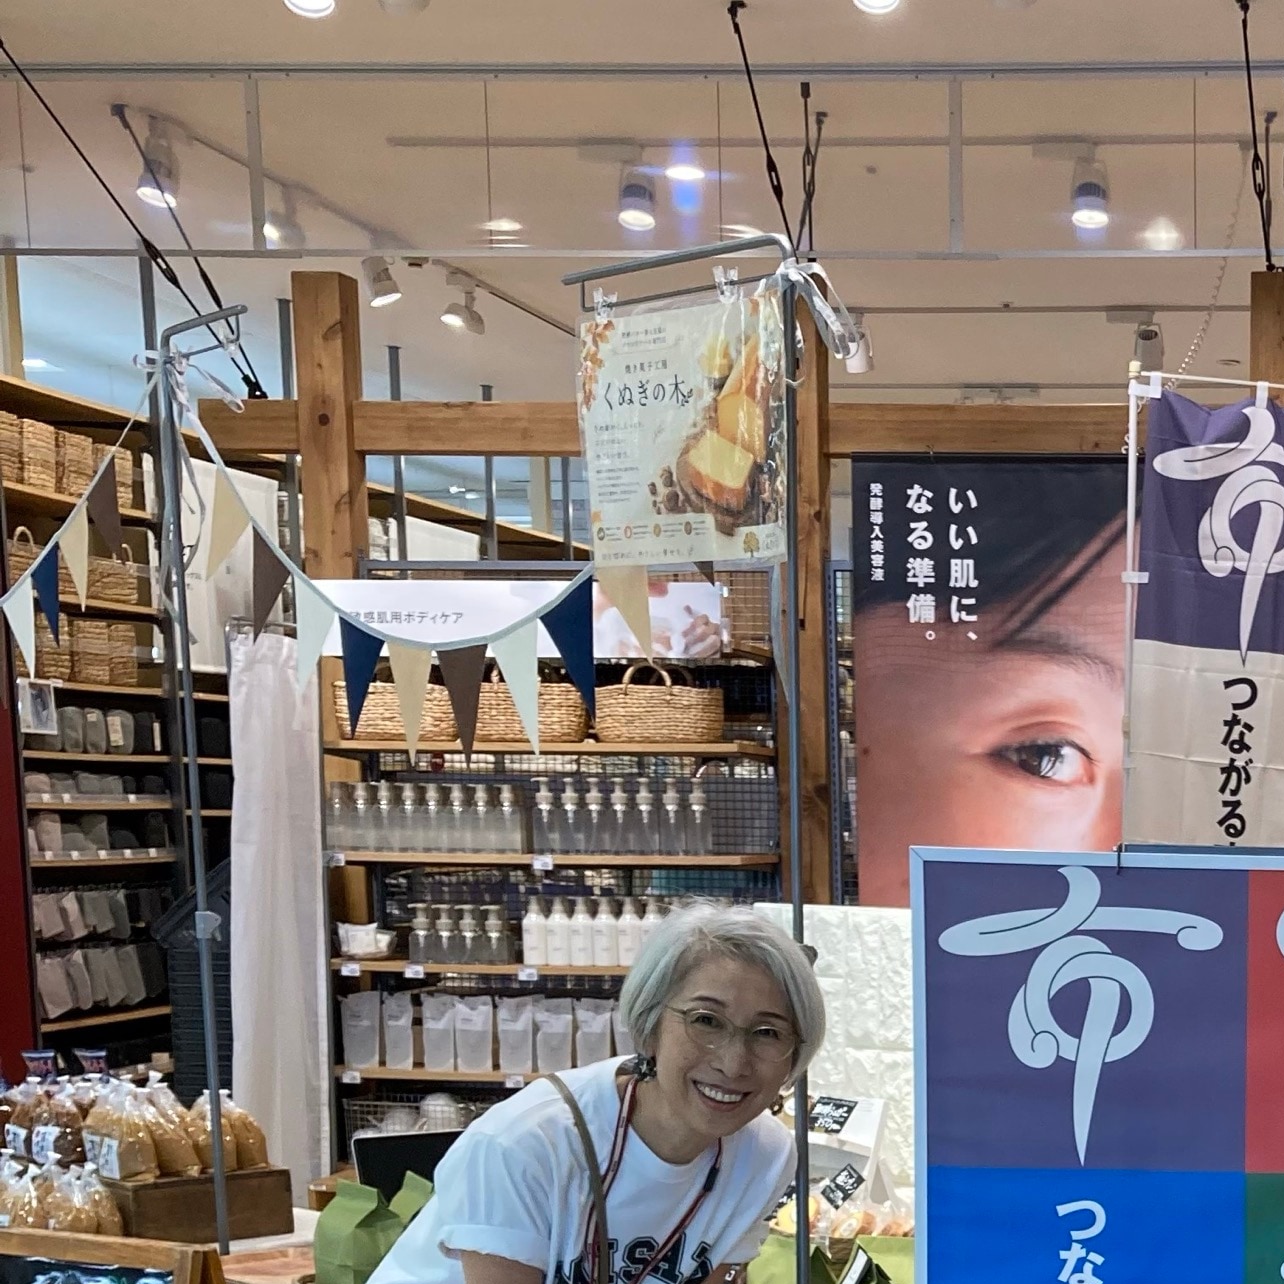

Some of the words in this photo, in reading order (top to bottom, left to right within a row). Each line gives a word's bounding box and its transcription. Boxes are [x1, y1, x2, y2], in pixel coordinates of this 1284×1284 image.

[604, 374, 686, 411] くぬぎの木
[868, 482, 886, 582] 発酵導入美容液
[905, 483, 937, 641] なる準備。
[948, 486, 980, 641] いい肌に、
[1214, 675, 1261, 847] つながる
